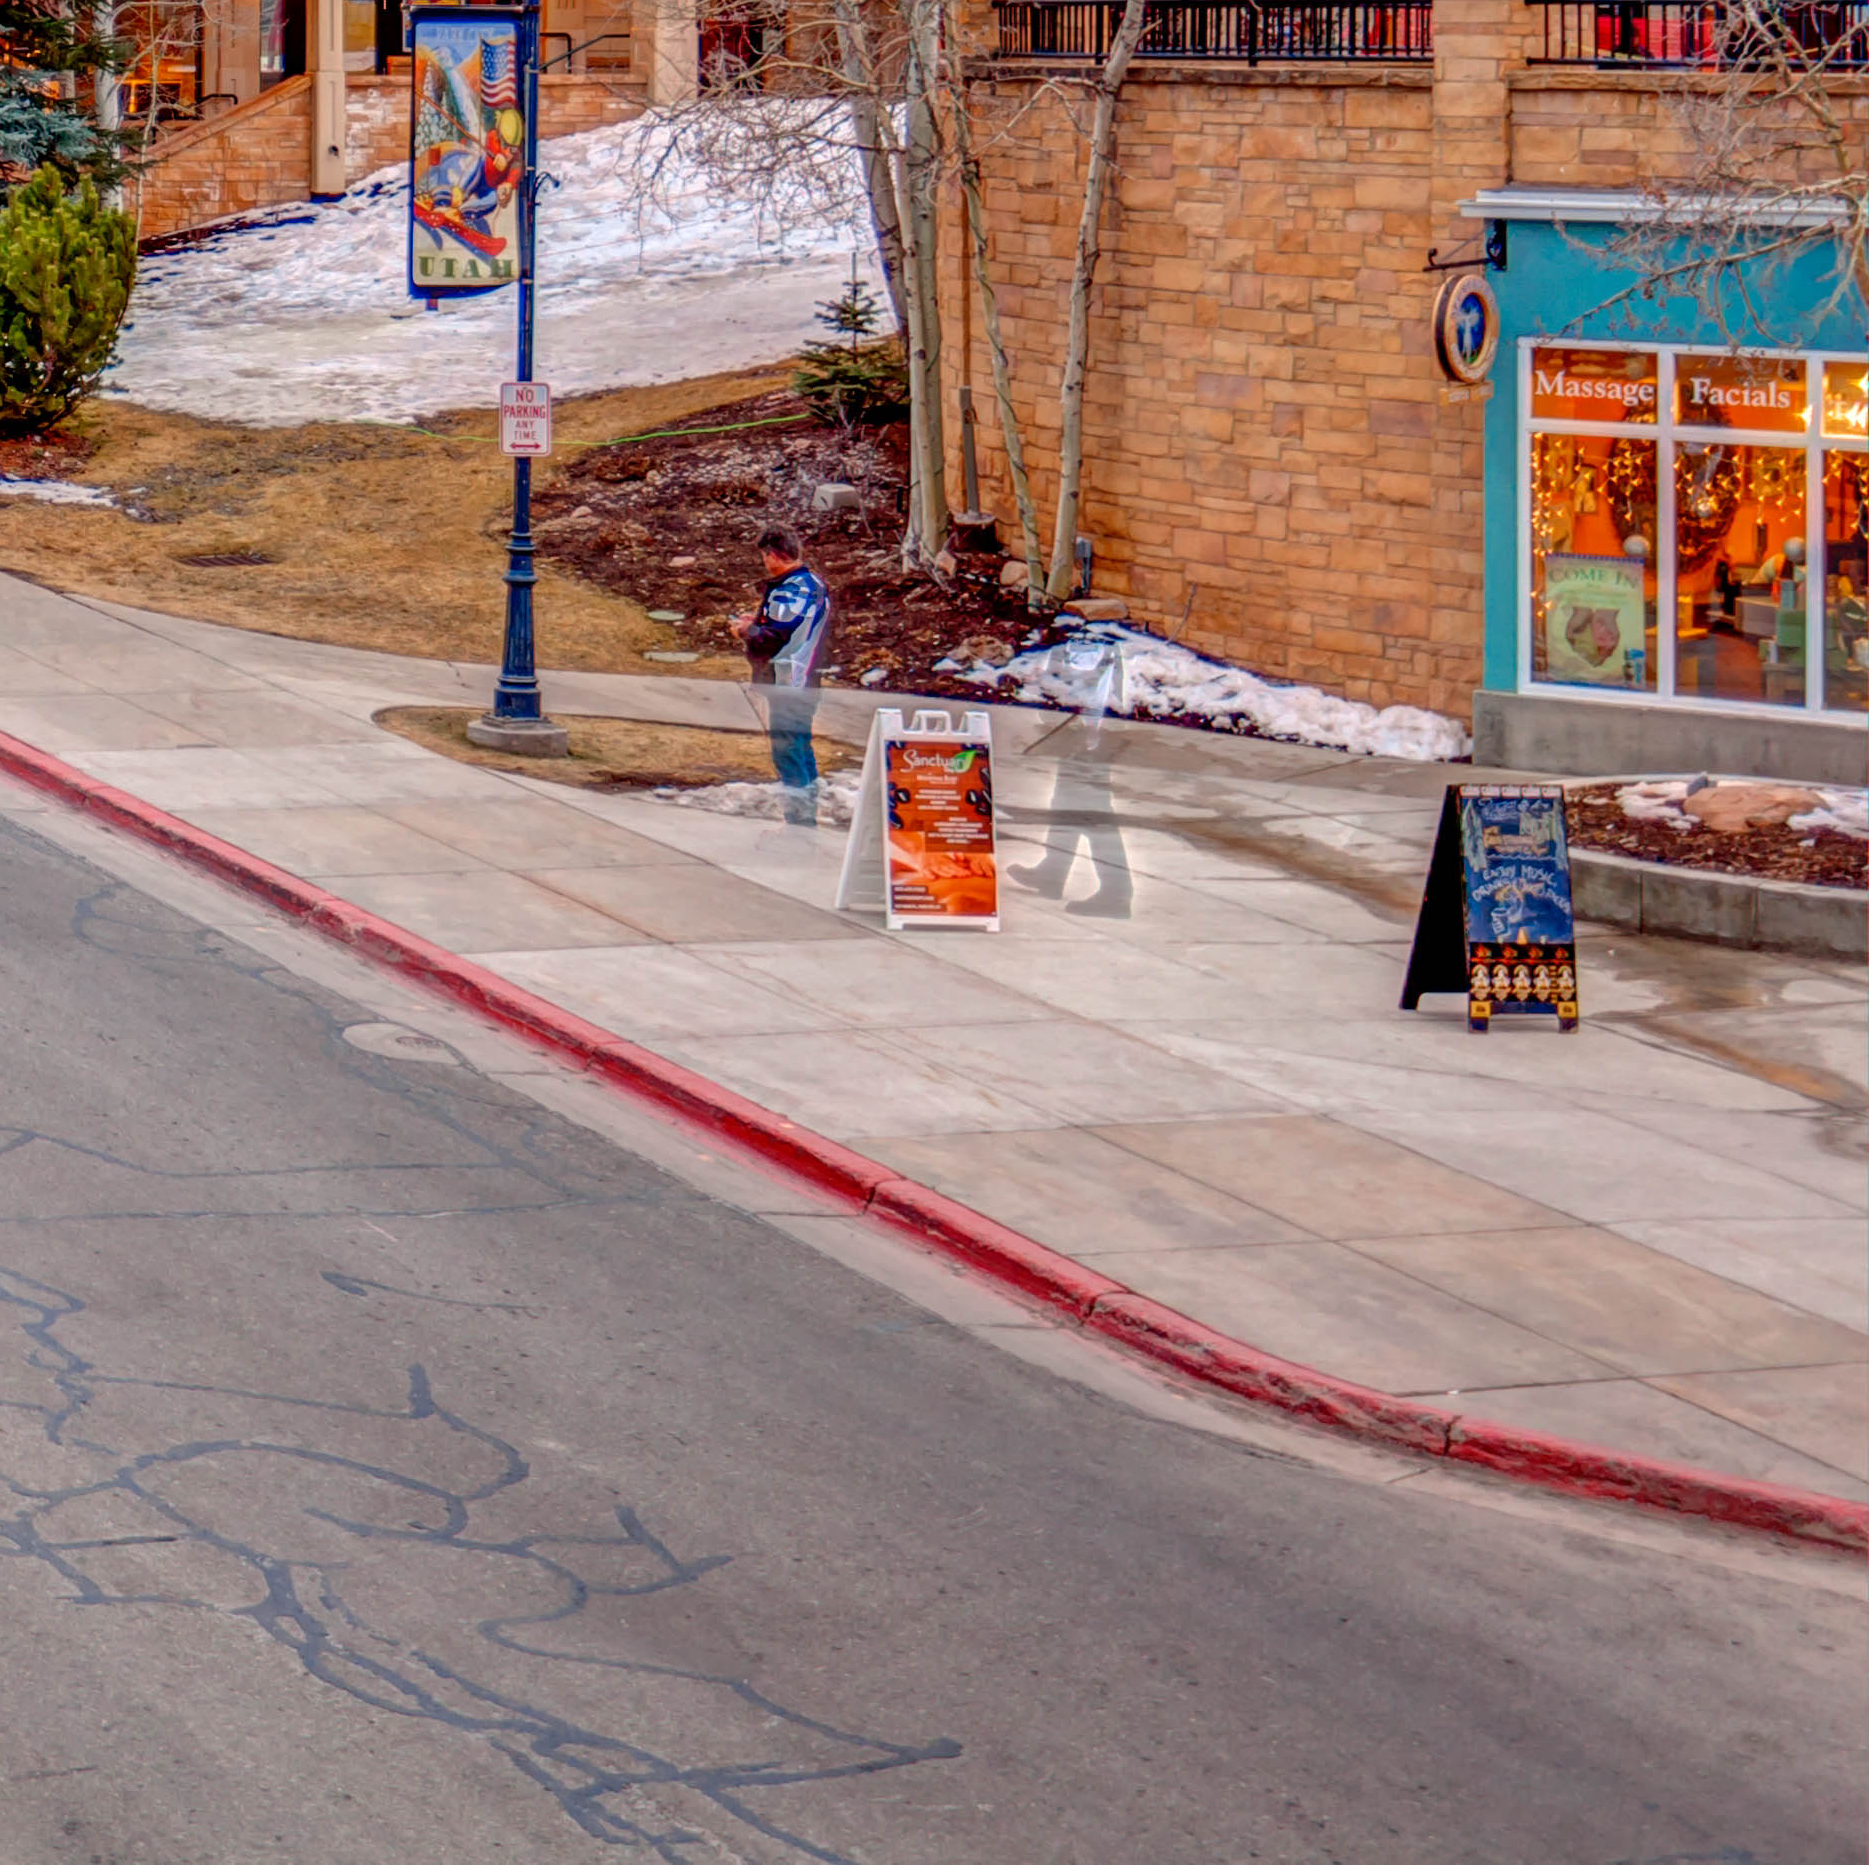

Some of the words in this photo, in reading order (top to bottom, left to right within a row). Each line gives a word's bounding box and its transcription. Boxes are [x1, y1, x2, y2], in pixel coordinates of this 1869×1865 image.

[418, 256, 514, 279] UTAH
[1534, 370, 1655, 407] Massage
[1690, 378, 1791, 409] Facials
[516, 389, 534, 403] NO
[504, 405, 546, 419] PARKING
[516, 420, 535, 429] ANY
[515, 430, 537, 440] TIME
